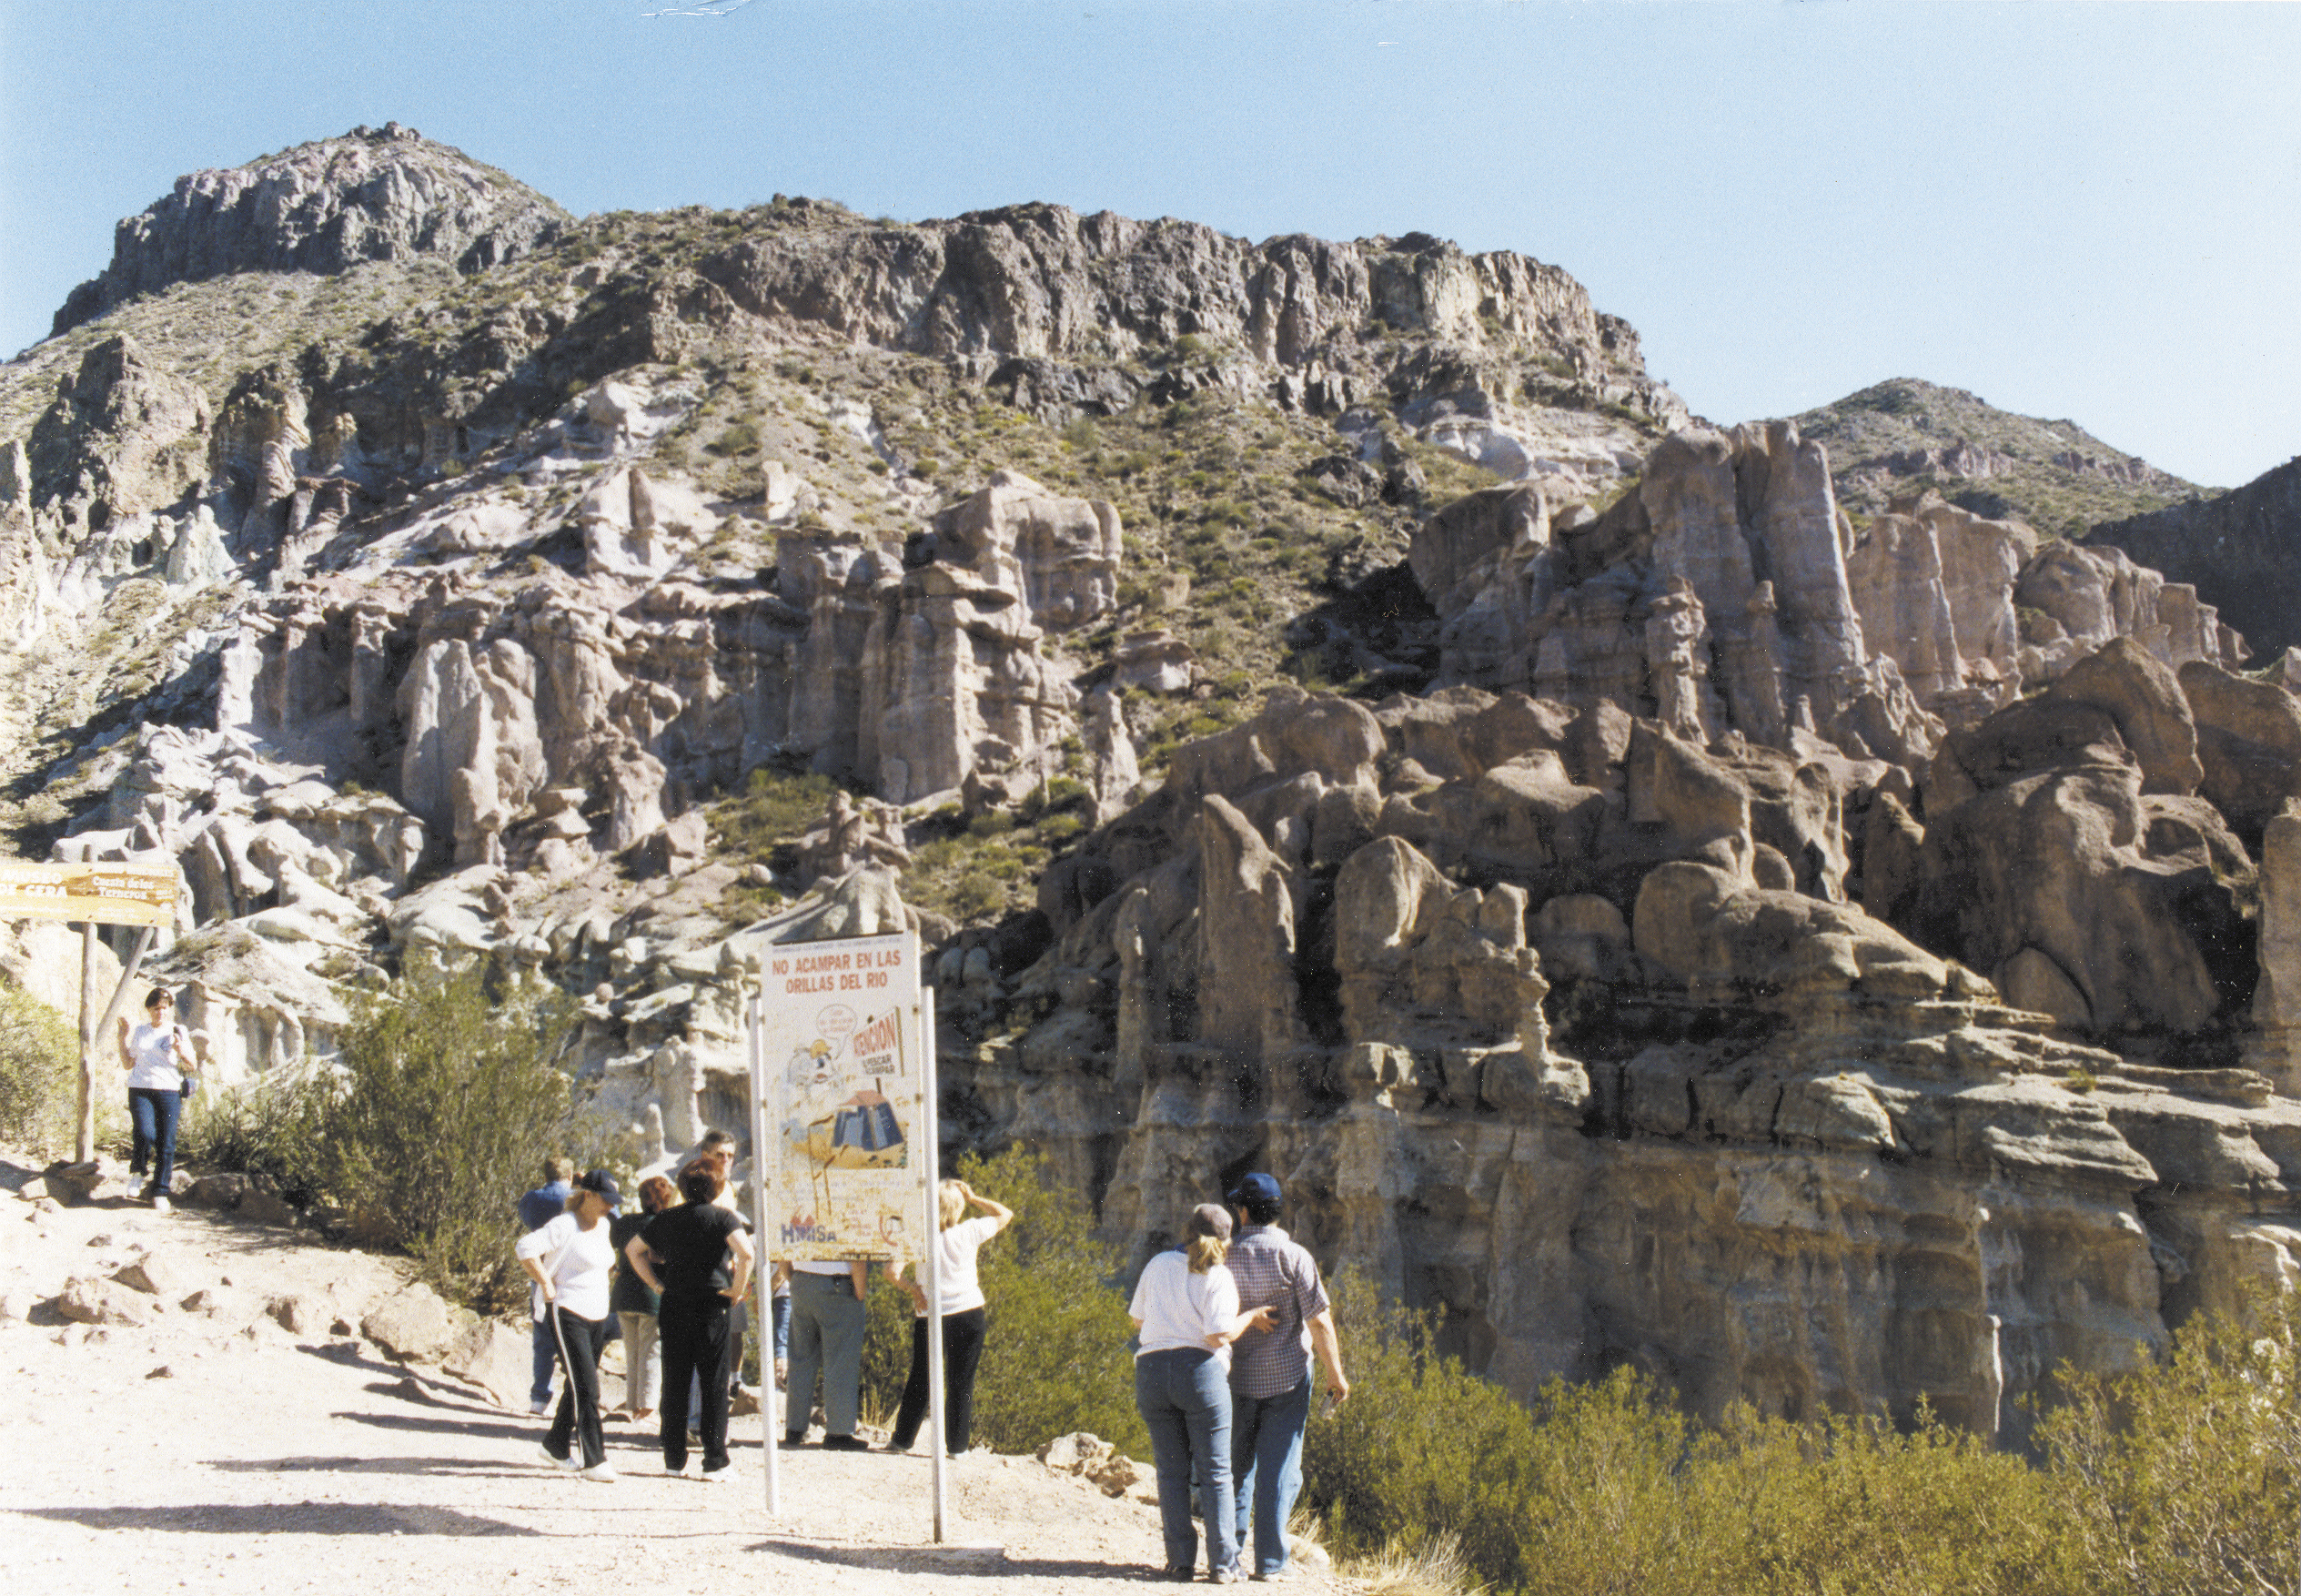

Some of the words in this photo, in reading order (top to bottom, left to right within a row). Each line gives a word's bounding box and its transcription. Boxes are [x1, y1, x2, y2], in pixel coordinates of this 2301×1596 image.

[25, 884, 67, 899] CERA
[773, 959, 789, 975] NO
[795, 954, 851, 974] ACAMPAR
[856, 952, 873, 969] EN
[877, 949, 902, 967] LAS
[785, 975, 834, 994] ORILLAS
[840, 974, 862, 990] DEL
[867, 972, 888, 988] RIO
